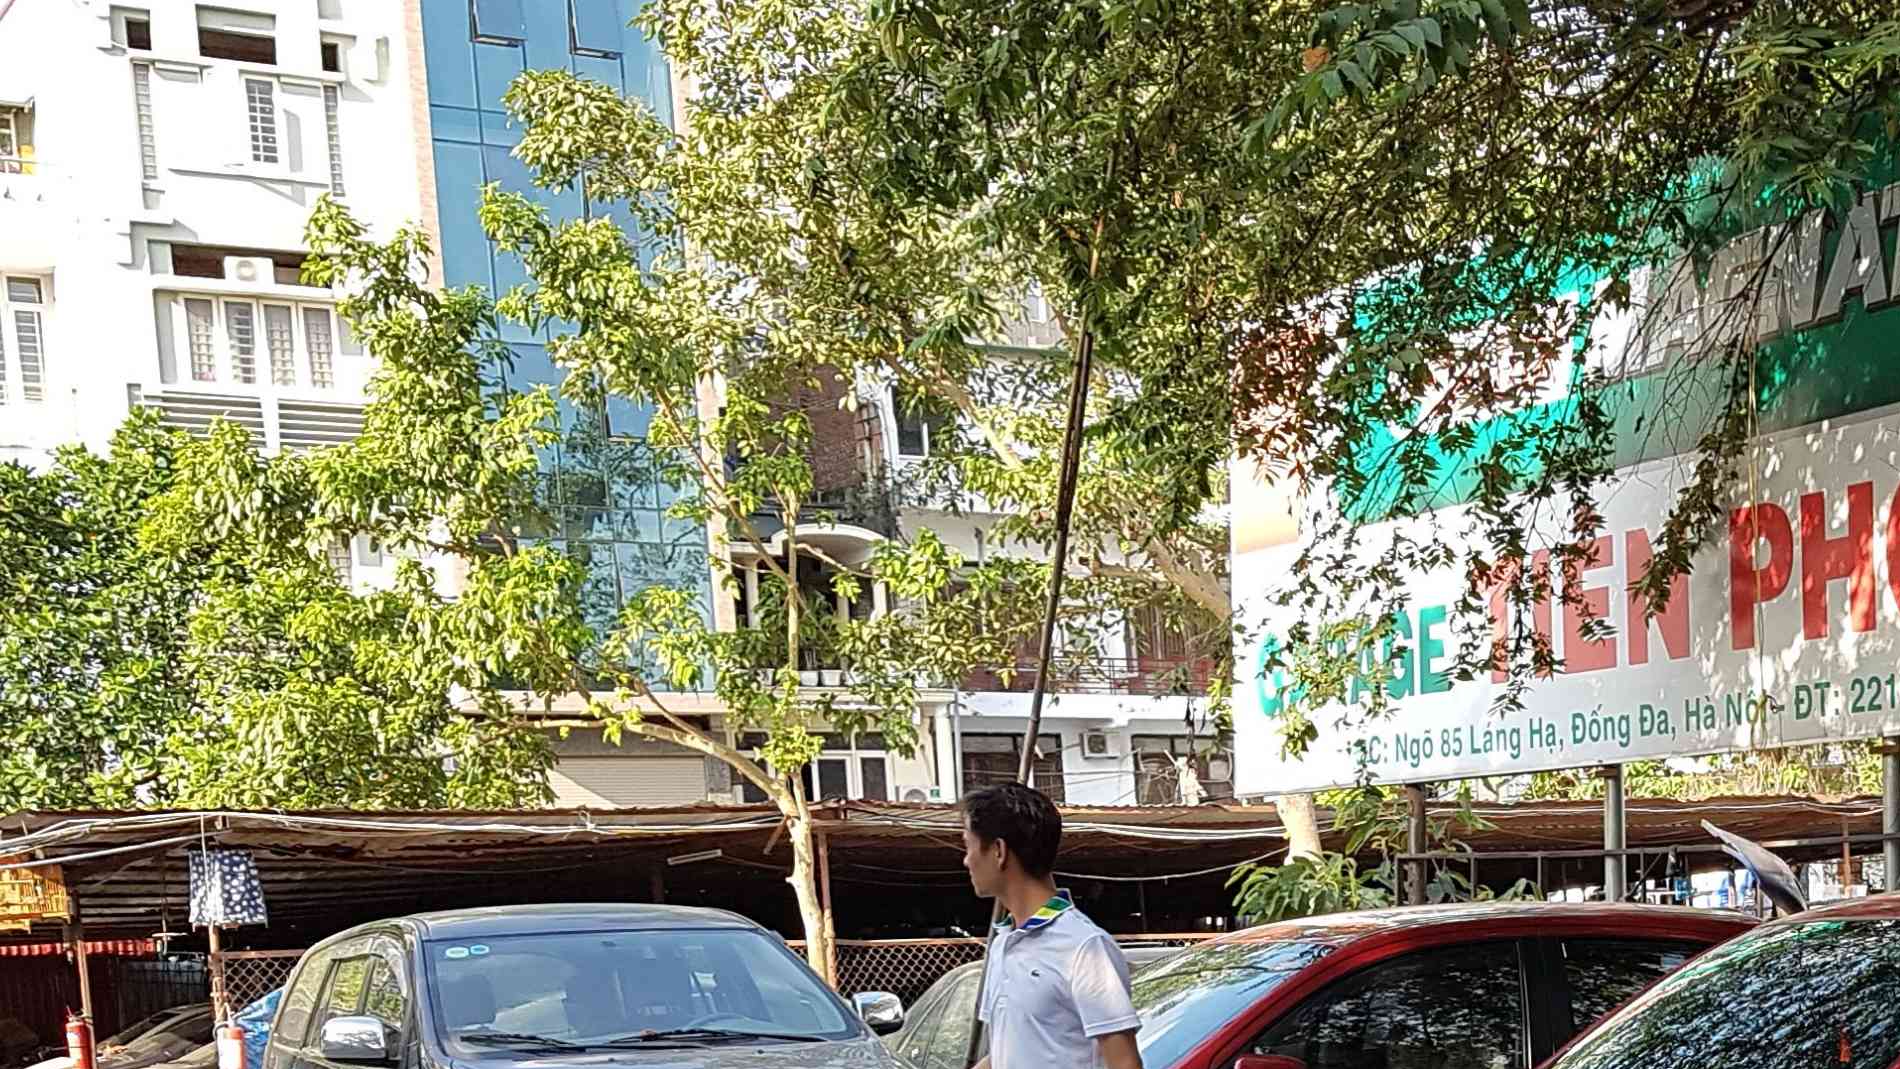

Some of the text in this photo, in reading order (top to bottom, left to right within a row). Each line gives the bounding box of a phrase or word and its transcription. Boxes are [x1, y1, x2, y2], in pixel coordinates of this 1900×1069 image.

[1395, 728, 1434, 768] Ngõ
[1441, 727, 1463, 758] 85
[1470, 721, 1522, 760] Láng
[1571, 703, 1631, 748] Đống
[1639, 703, 1677, 741] Đa,
[1685, 696, 1716, 732] Hà
[1795, 680, 1840, 720] ĐT:
